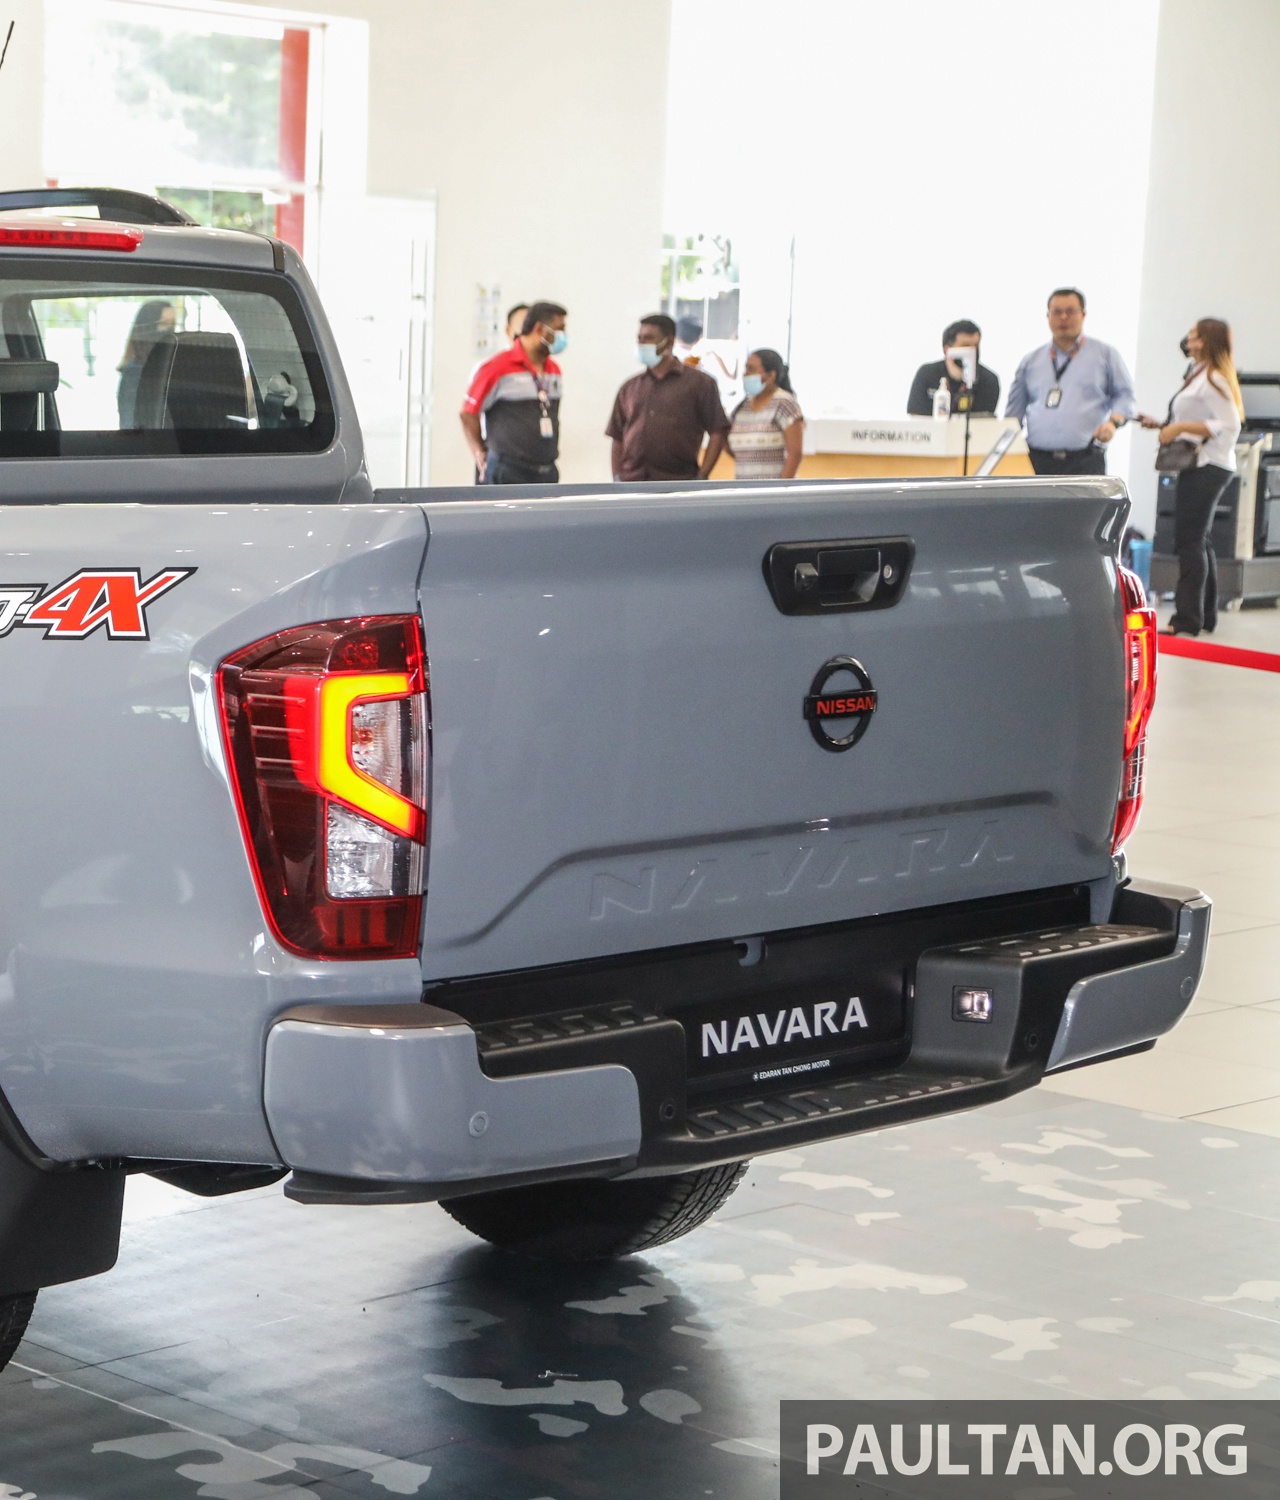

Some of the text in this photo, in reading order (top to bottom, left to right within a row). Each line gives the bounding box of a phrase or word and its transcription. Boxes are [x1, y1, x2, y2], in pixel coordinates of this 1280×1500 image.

[851, 429, 932, 442] INFORMATION
[816, 696, 875, 715] NISSAN
[588, 819, 1017, 921] NAVARA
[701, 996, 869, 1058] NAVARA
[759, 1059, 830, 1080] EDARAN TAN CHONG MOTOR
